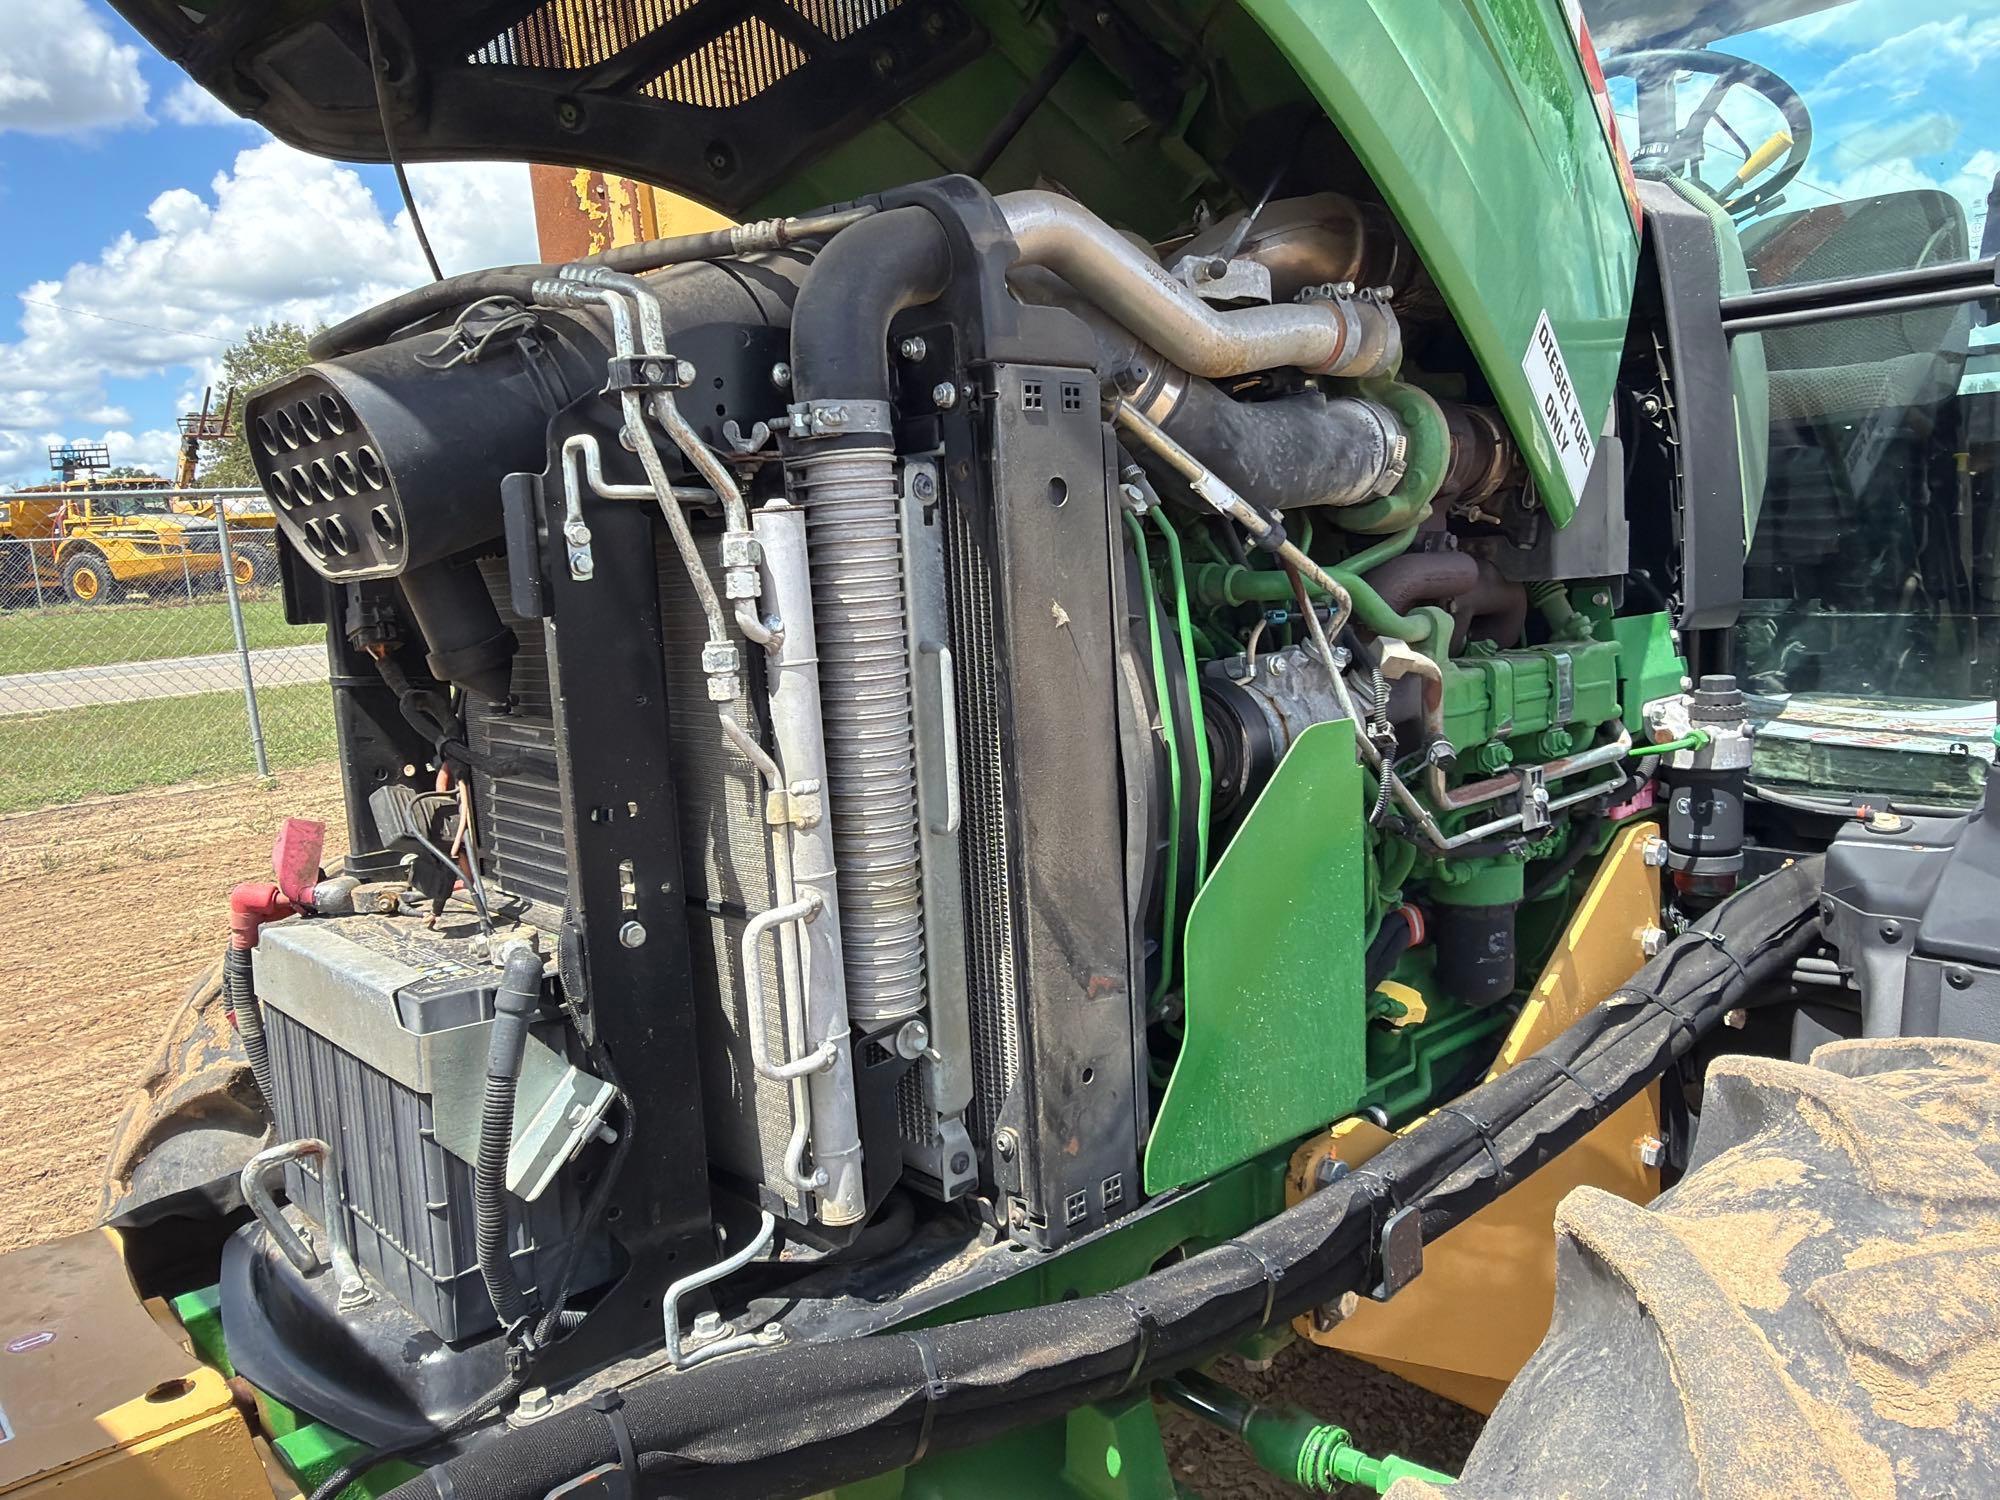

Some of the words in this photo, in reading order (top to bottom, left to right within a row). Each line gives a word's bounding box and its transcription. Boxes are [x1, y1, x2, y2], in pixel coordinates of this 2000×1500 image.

[1539, 324, 1570, 413] DIESEL
[1570, 409, 1591, 467] FUEL
[1545, 393, 1569, 453] ONLY
